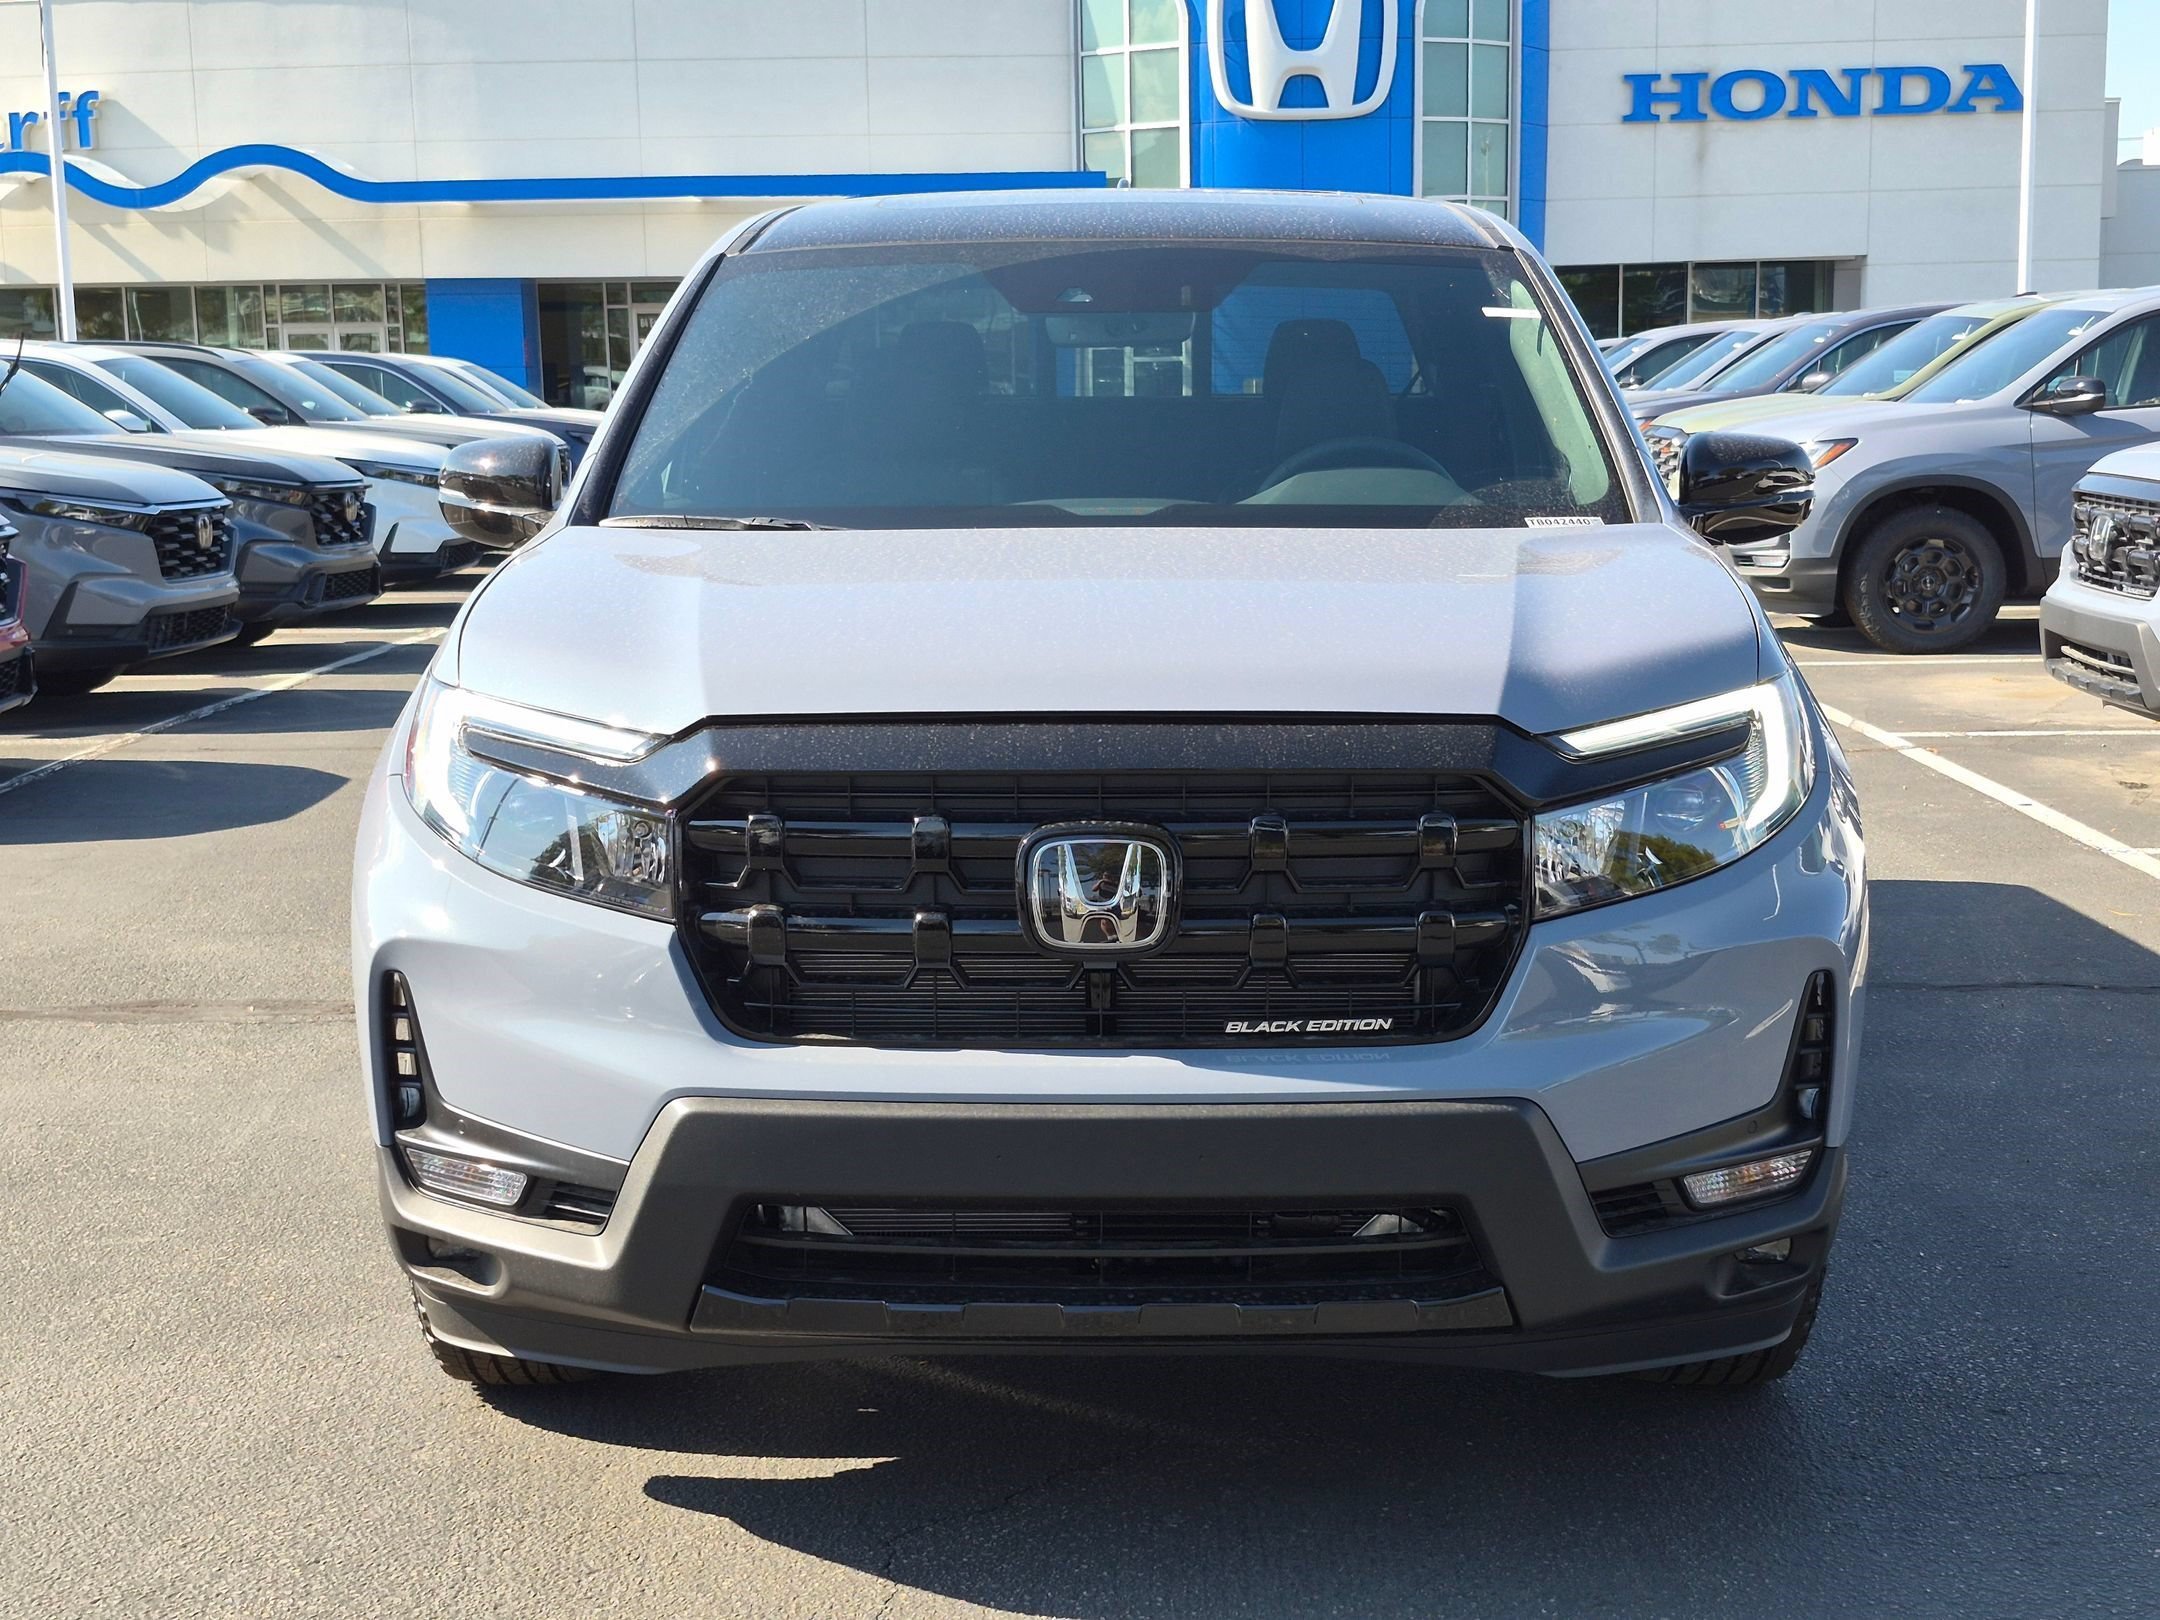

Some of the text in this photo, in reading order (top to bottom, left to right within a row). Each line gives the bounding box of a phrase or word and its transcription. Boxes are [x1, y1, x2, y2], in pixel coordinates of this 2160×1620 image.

[1622, 64, 2024, 122] HONDA
[1225, 1018, 1393, 1033] BLACK EDITION
